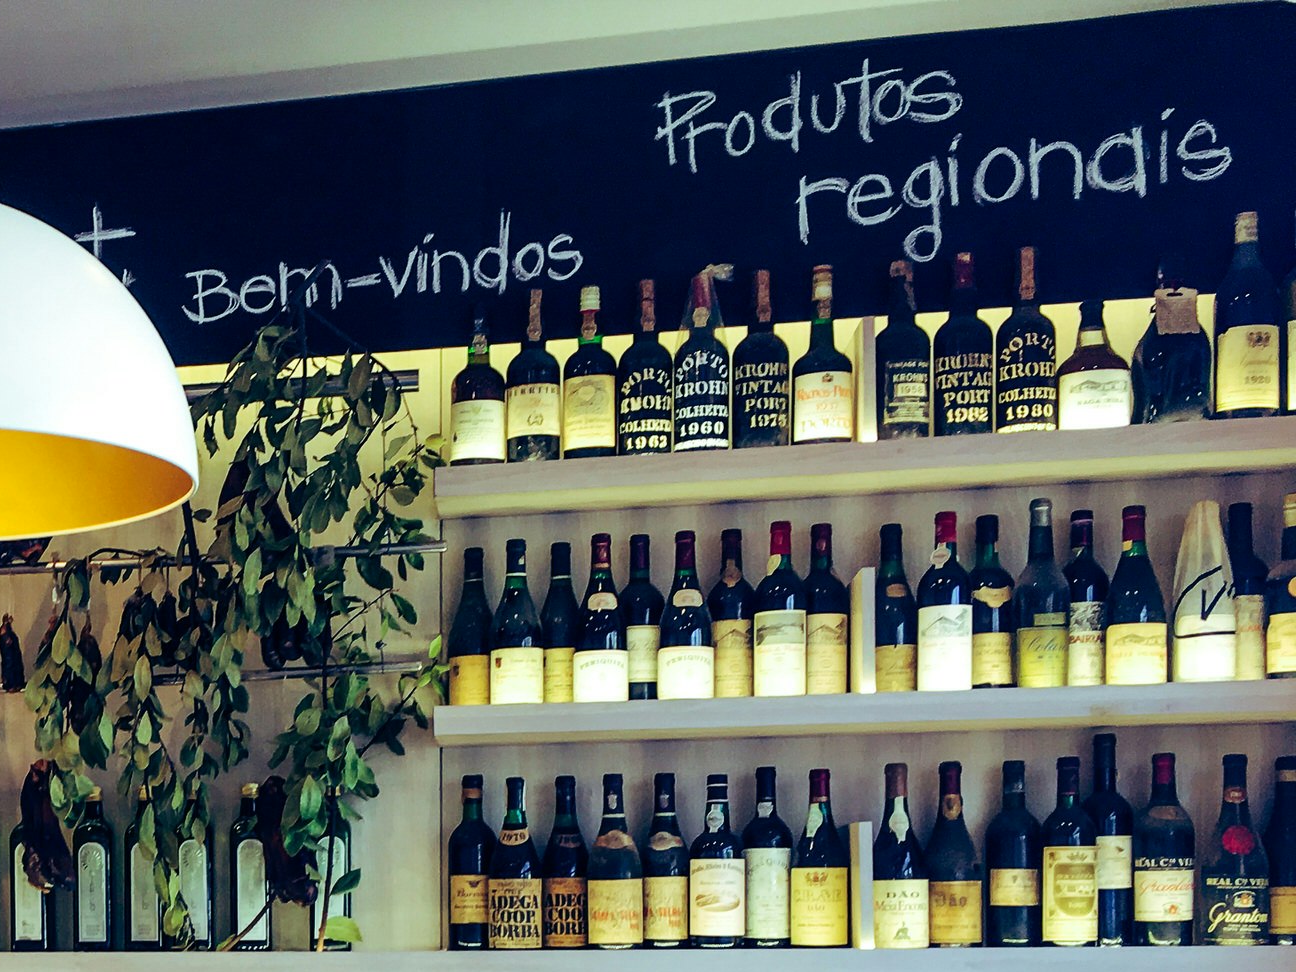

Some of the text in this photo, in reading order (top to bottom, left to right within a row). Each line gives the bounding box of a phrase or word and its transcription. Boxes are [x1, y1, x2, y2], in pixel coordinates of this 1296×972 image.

[654, 58, 963, 173] Produtos
[796, 107, 1233, 262] regionais
[181, 207, 585, 325] Bem-vindos
[1005, 403, 1054, 421] 1980
[679, 420, 725, 438] 1960
[490, 895, 539, 910] ADEGA
[547, 907, 583, 922] COO
